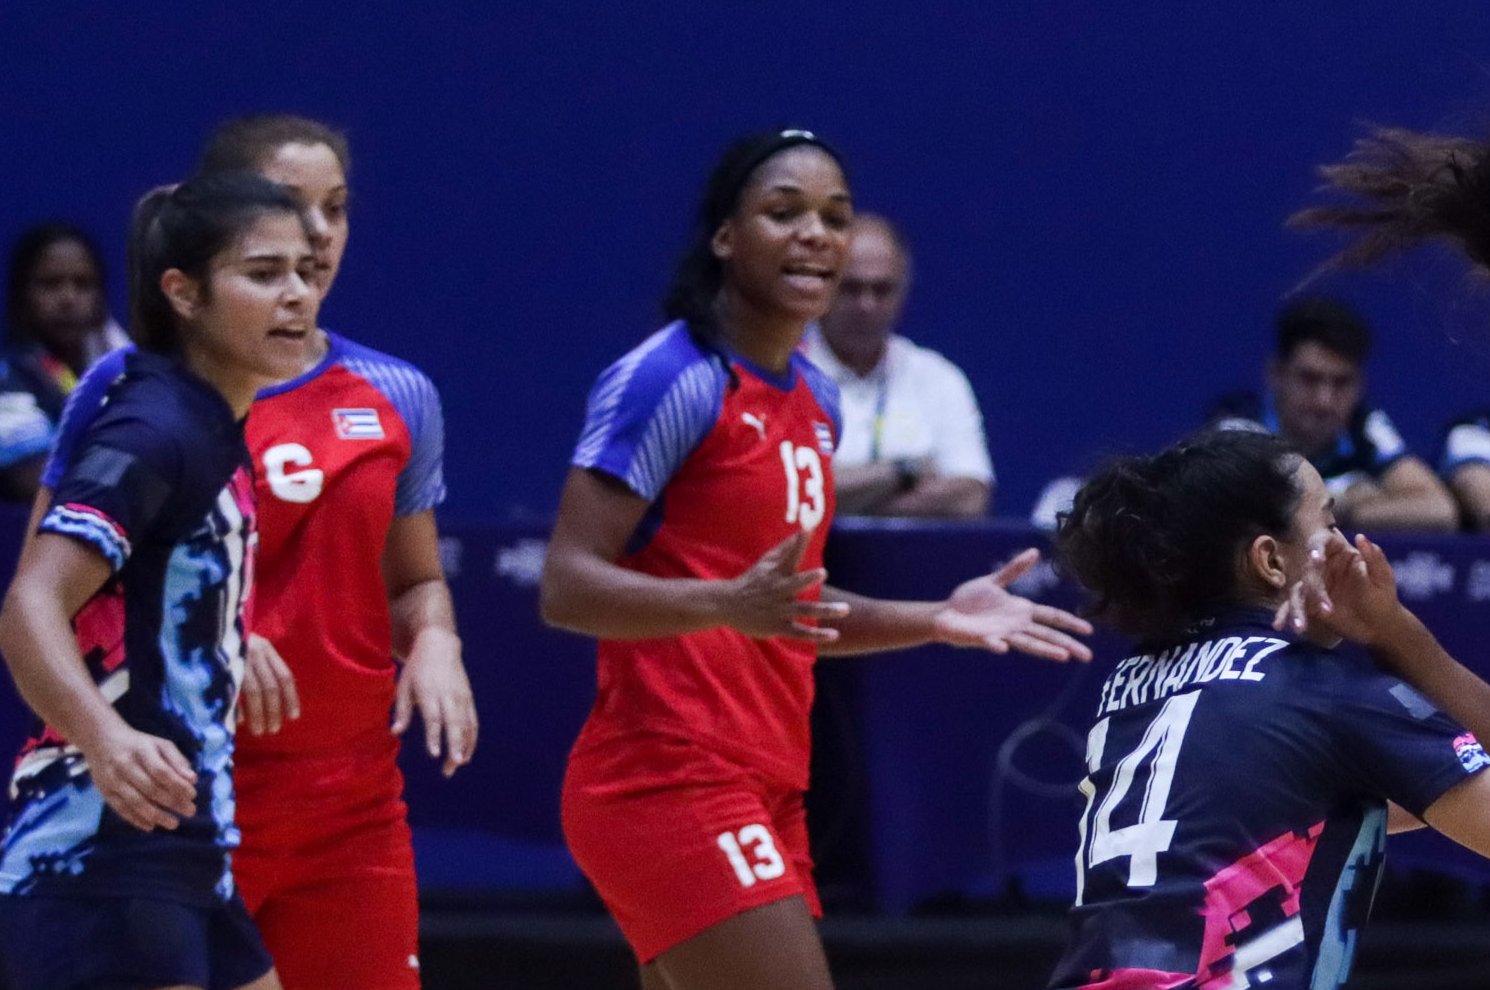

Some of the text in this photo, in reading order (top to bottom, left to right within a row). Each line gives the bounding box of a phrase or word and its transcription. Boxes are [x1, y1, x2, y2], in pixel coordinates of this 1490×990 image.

[262, 443, 324, 503] 6
[779, 440, 825, 532] 13
[1076, 688, 1203, 907] 14
[717, 823, 785, 888] 13
